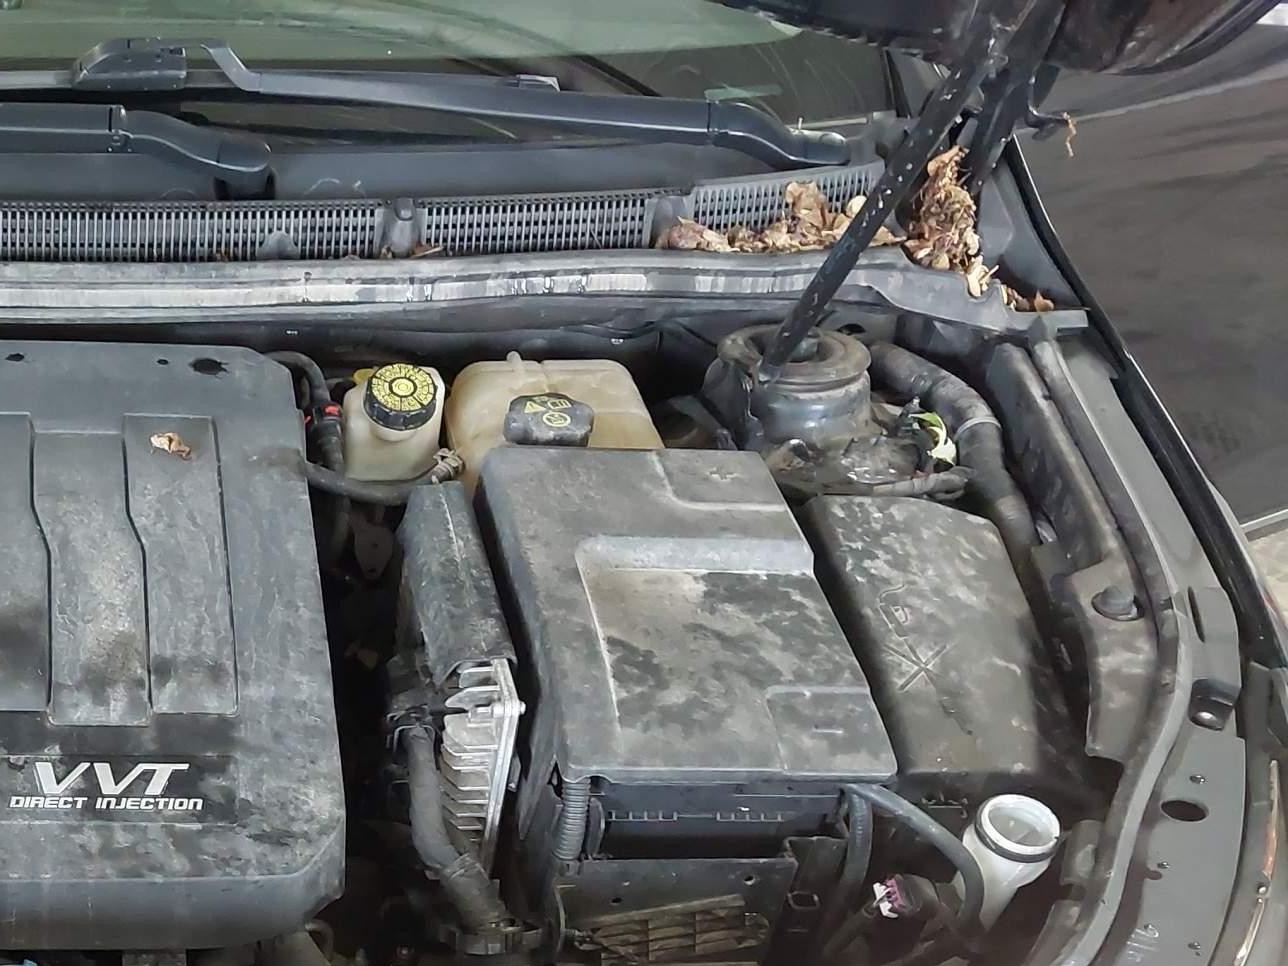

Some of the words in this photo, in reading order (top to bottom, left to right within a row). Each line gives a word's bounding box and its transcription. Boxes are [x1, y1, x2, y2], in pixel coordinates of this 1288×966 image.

[33, 761, 191, 796] VVT
[9, 795, 89, 810] DIRECT
[95, 796, 204, 811] INJECTION
